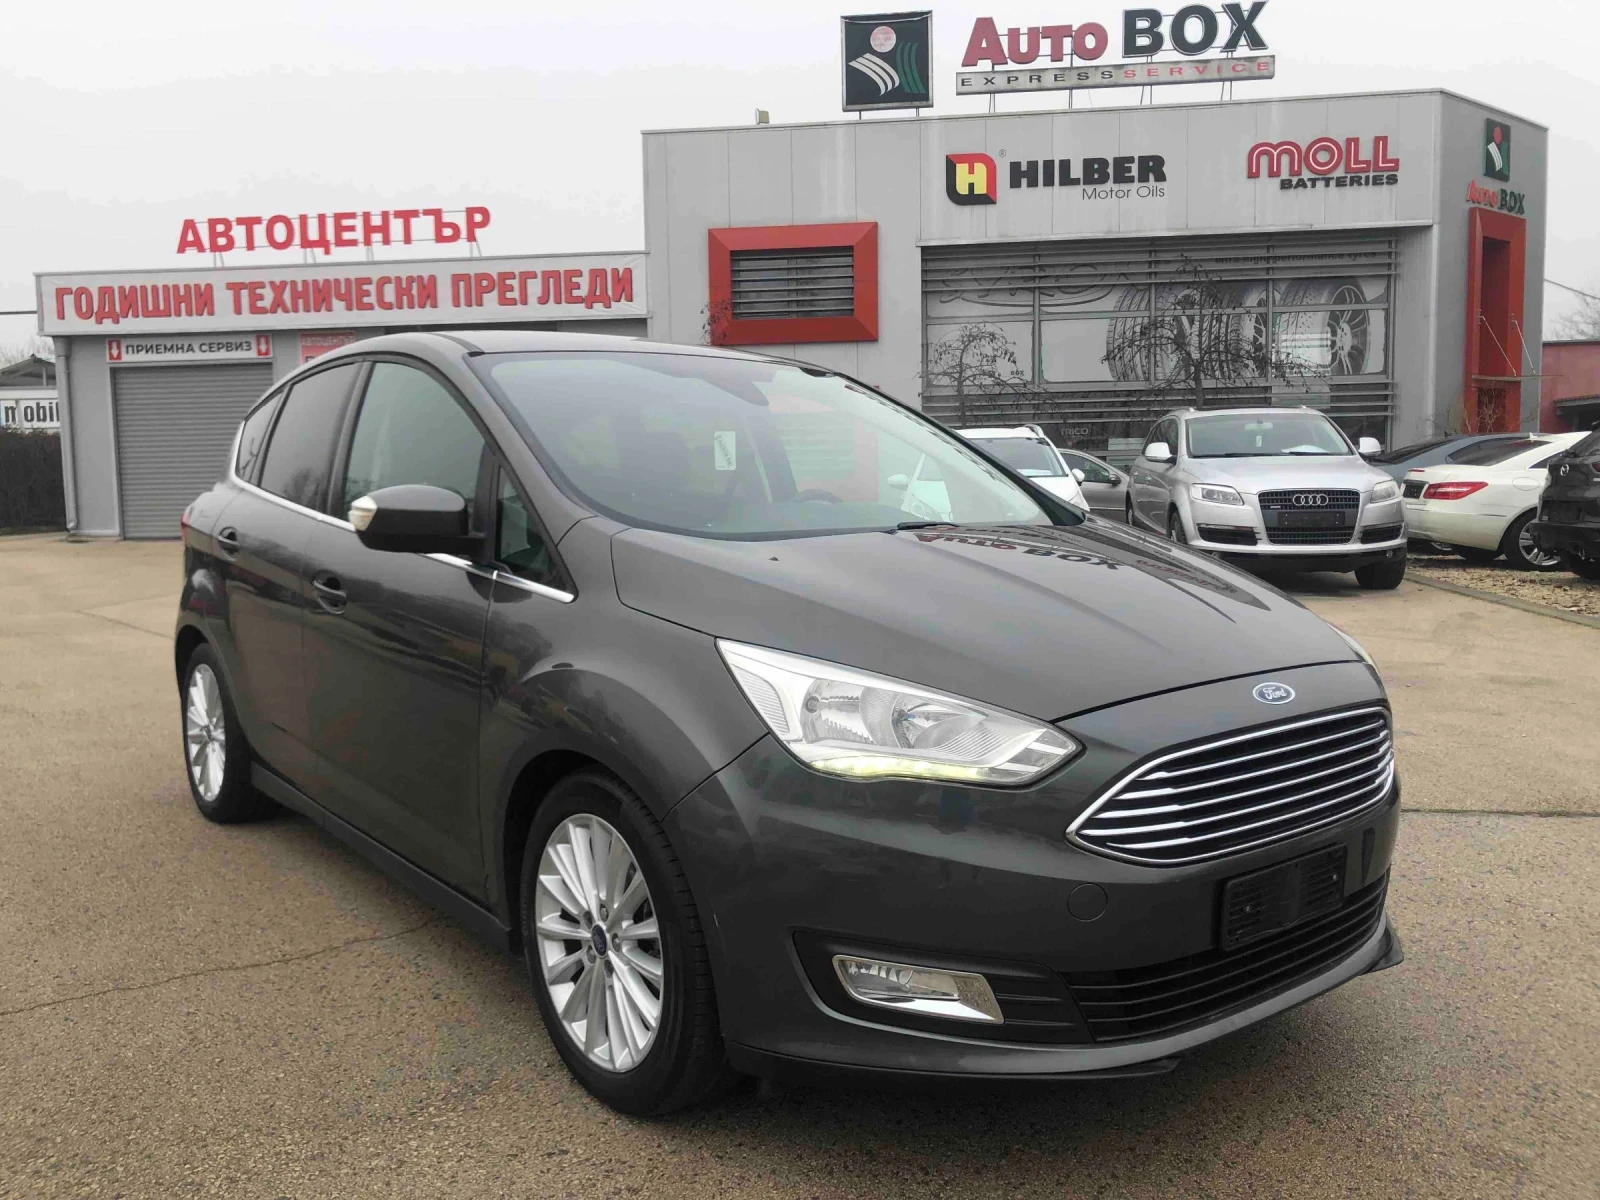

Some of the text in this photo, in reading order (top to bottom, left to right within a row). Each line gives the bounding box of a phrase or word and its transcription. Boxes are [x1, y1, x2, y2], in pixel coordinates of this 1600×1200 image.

[1122, 0, 1268, 58] BOX
[1009, 154, 1167, 189] HILBER
[1280, 173, 1399, 190] BATTERIES
[1082, 185, 1165, 201] Motor Oils
[1499, 188, 1525, 215] BOX
[176, 206, 491, 254] АВТОЦЕНТЪР
[55, 267, 634, 325] ГОДИШНИ ТЕХНИЧЕСКИ ПРЕГЛЕДИ
[125, 341, 252, 355] ПРИЕМНА СЕРВИЗ
